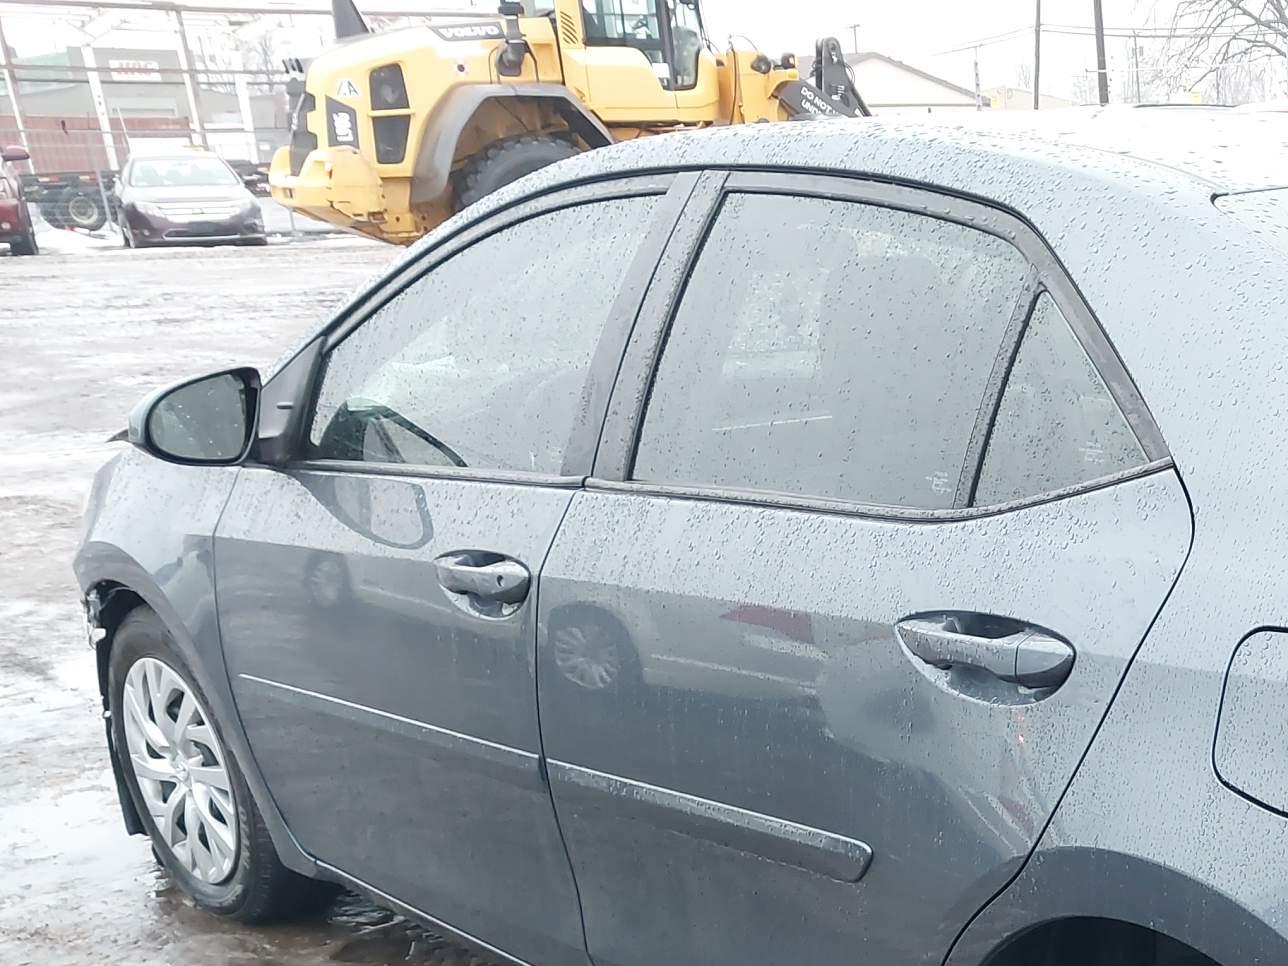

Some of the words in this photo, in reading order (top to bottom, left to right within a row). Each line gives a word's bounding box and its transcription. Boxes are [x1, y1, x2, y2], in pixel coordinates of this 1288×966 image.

[437, 25, 500, 38] VOLVO
[800, 86, 815, 100] DO
[813, 96, 834, 114] NOT
